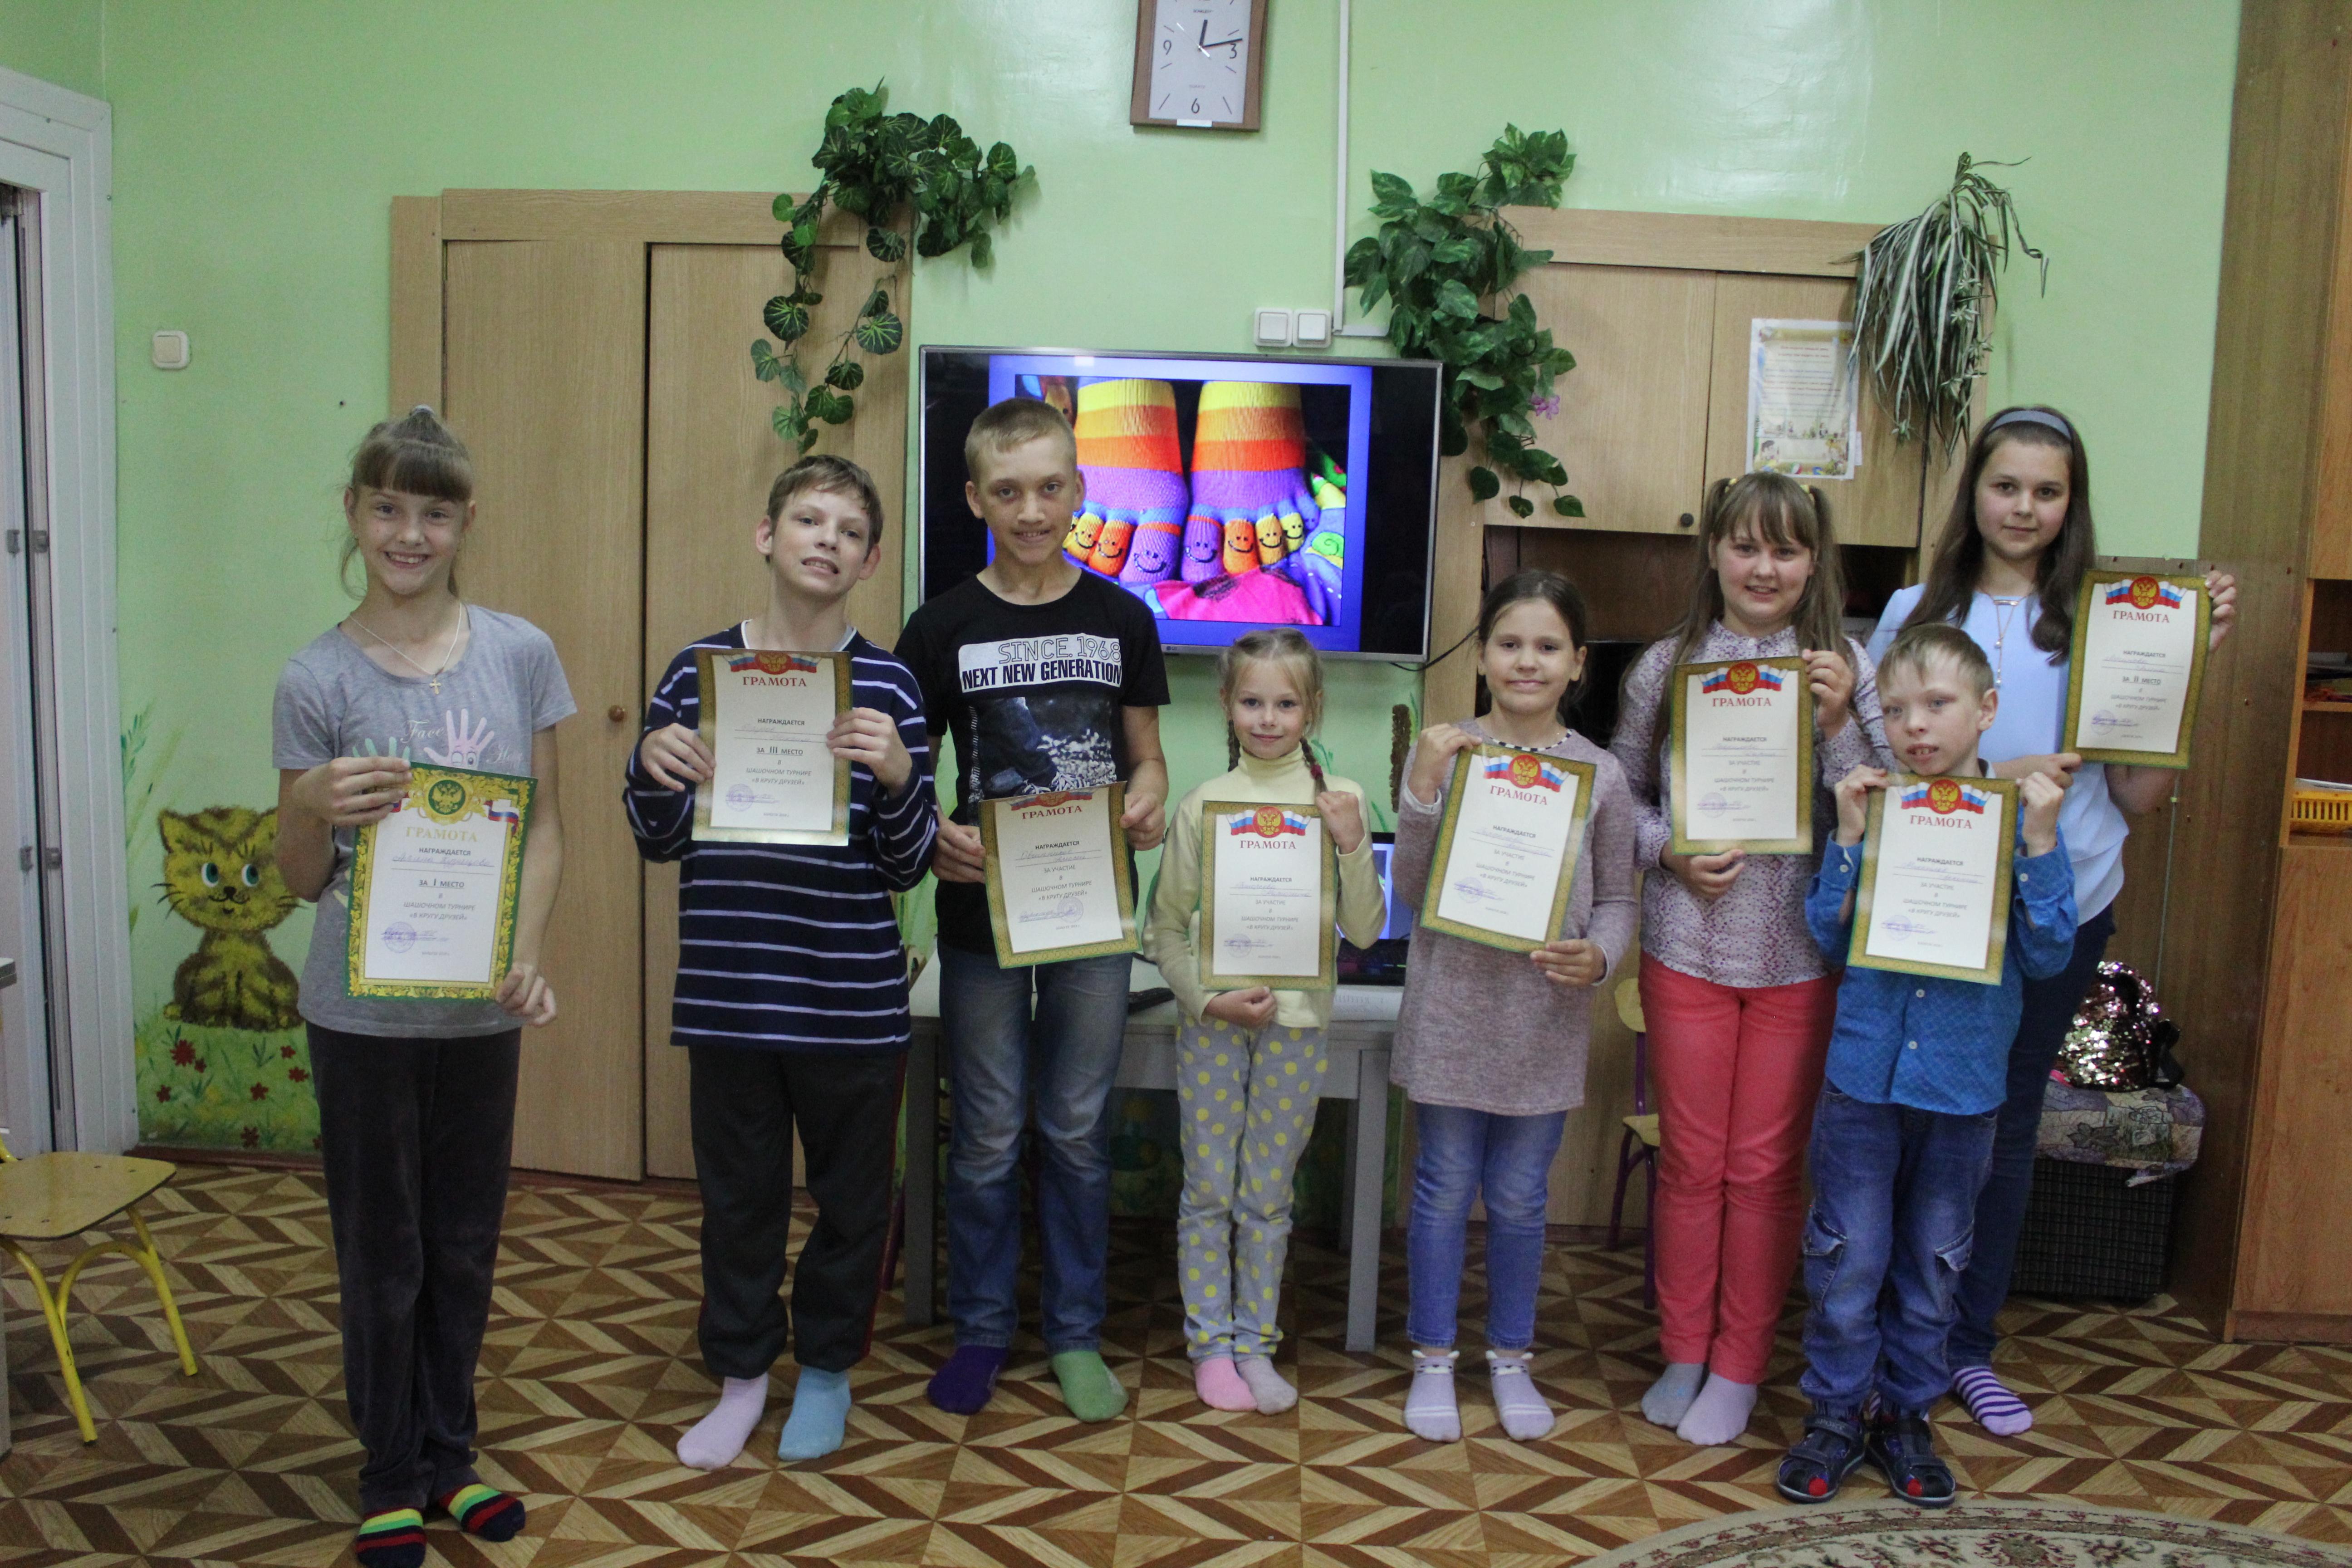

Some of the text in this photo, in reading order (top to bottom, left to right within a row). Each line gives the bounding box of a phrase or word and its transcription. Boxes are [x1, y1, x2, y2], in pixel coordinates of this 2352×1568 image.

[1163, 40, 1171, 55] 9
[1229, 43, 1237, 59] 3
[1191, 98, 1200, 113] 6
[2113, 610, 2170, 623] ГРАМОТА
[998, 636, 1121, 664] SINCE. 1968
[962, 658, 1122, 690] NEXT NEW GENERATION
[743, 676, 807, 687] ГРАМОТА
[1712, 697, 1772, 707] ГРАМОТА
[400, 719, 444, 743] Face
[1490, 785, 1548, 805] ГРАМОТА
[1021, 805, 1083, 819] ГРАМОТА
[1909, 814, 1973, 829] ГРАМОТА
[406, 826, 478, 842] ГРАМОТА
[419, 848, 471, 856] НАГРАЖДАЕТСЯ
[1035, 841, 1080, 850] НАГРАЖДАЕТСЯ
[1240, 840, 1296, 850] ГРАМОТА
[1052, 864, 1076, 872] УЧАСТИЕ
[1031, 884, 1067, 893] ШАШОЧНОМ
